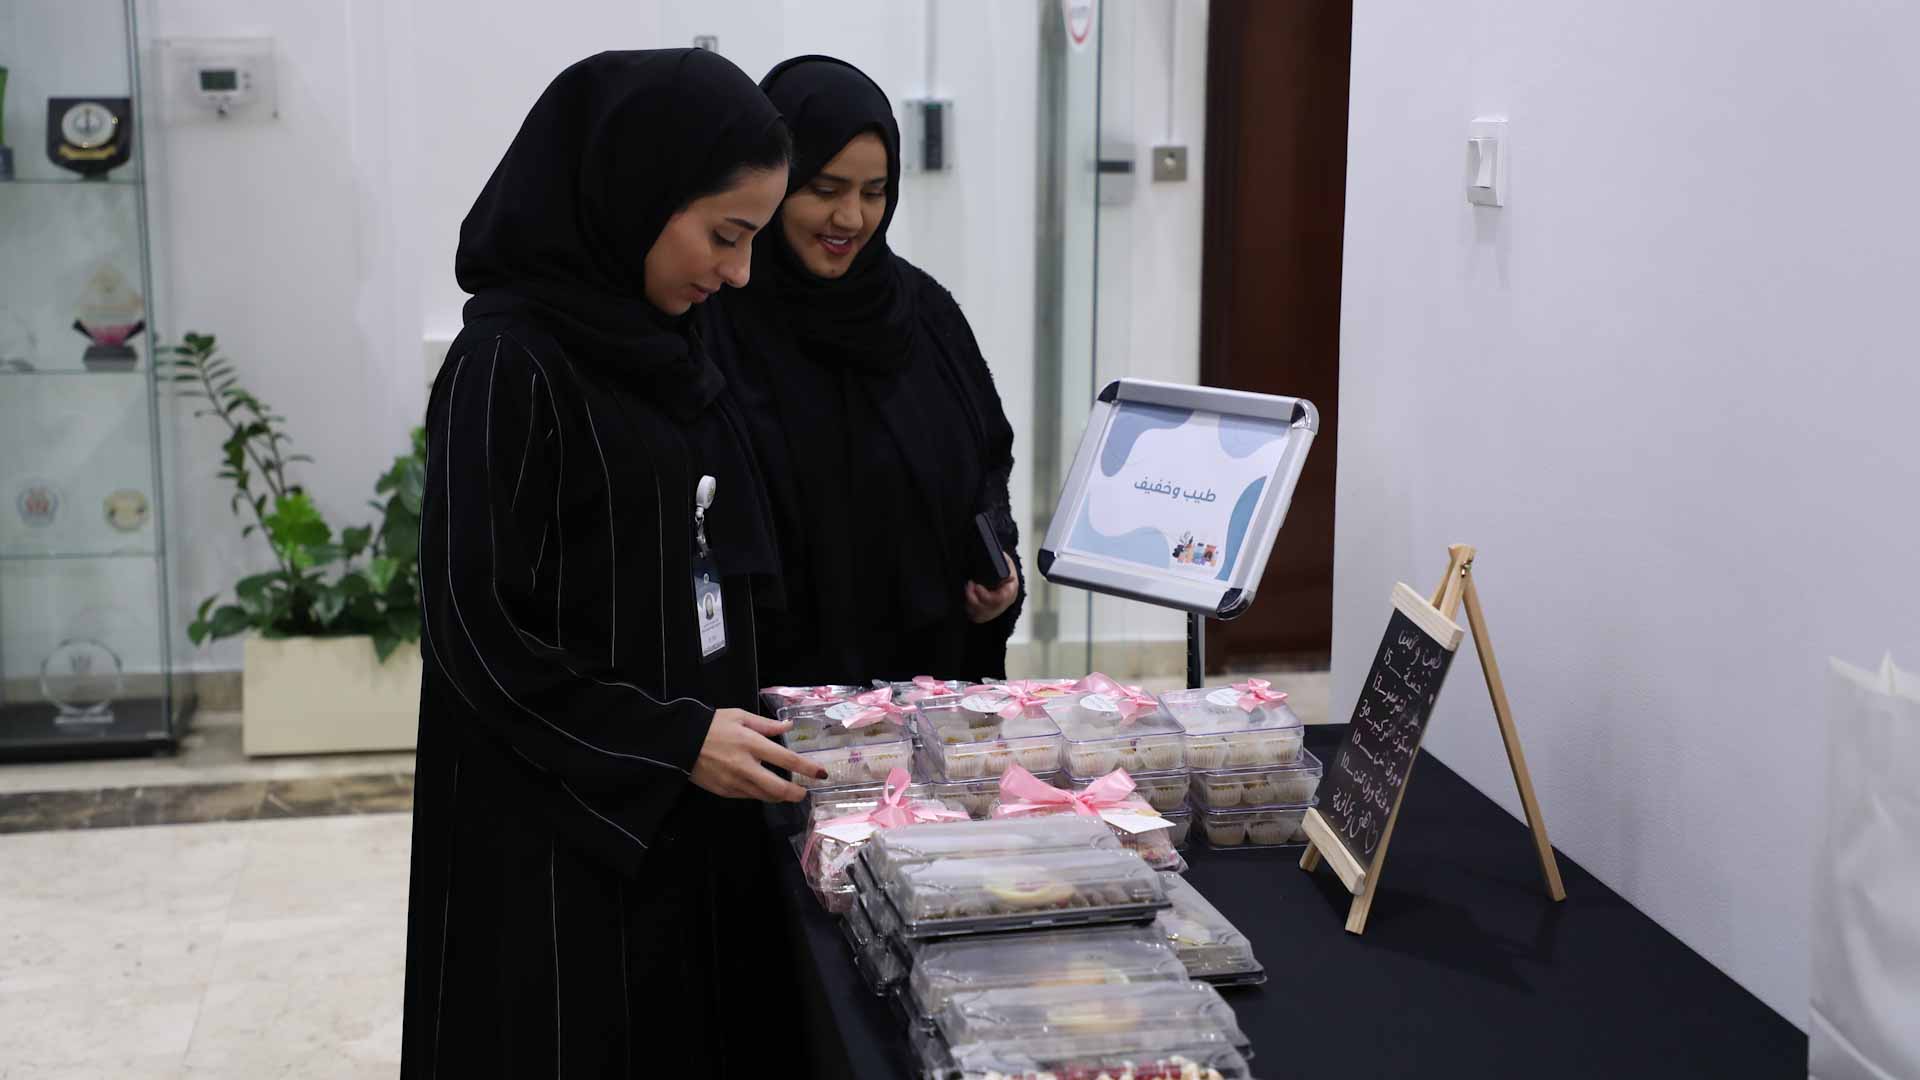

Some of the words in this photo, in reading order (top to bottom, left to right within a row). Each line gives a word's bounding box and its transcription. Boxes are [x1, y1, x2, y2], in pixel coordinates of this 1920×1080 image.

[1134, 476, 1181, 499] وخفيف
[1183, 488, 1216, 504] طيب
[1384, 647, 1394, 665] 15
[1372, 671, 1383, 691] 13
[1359, 698, 1371, 718] 30
[1352, 728, 1361, 745] 10
[1341, 751, 1350, 769] 10
